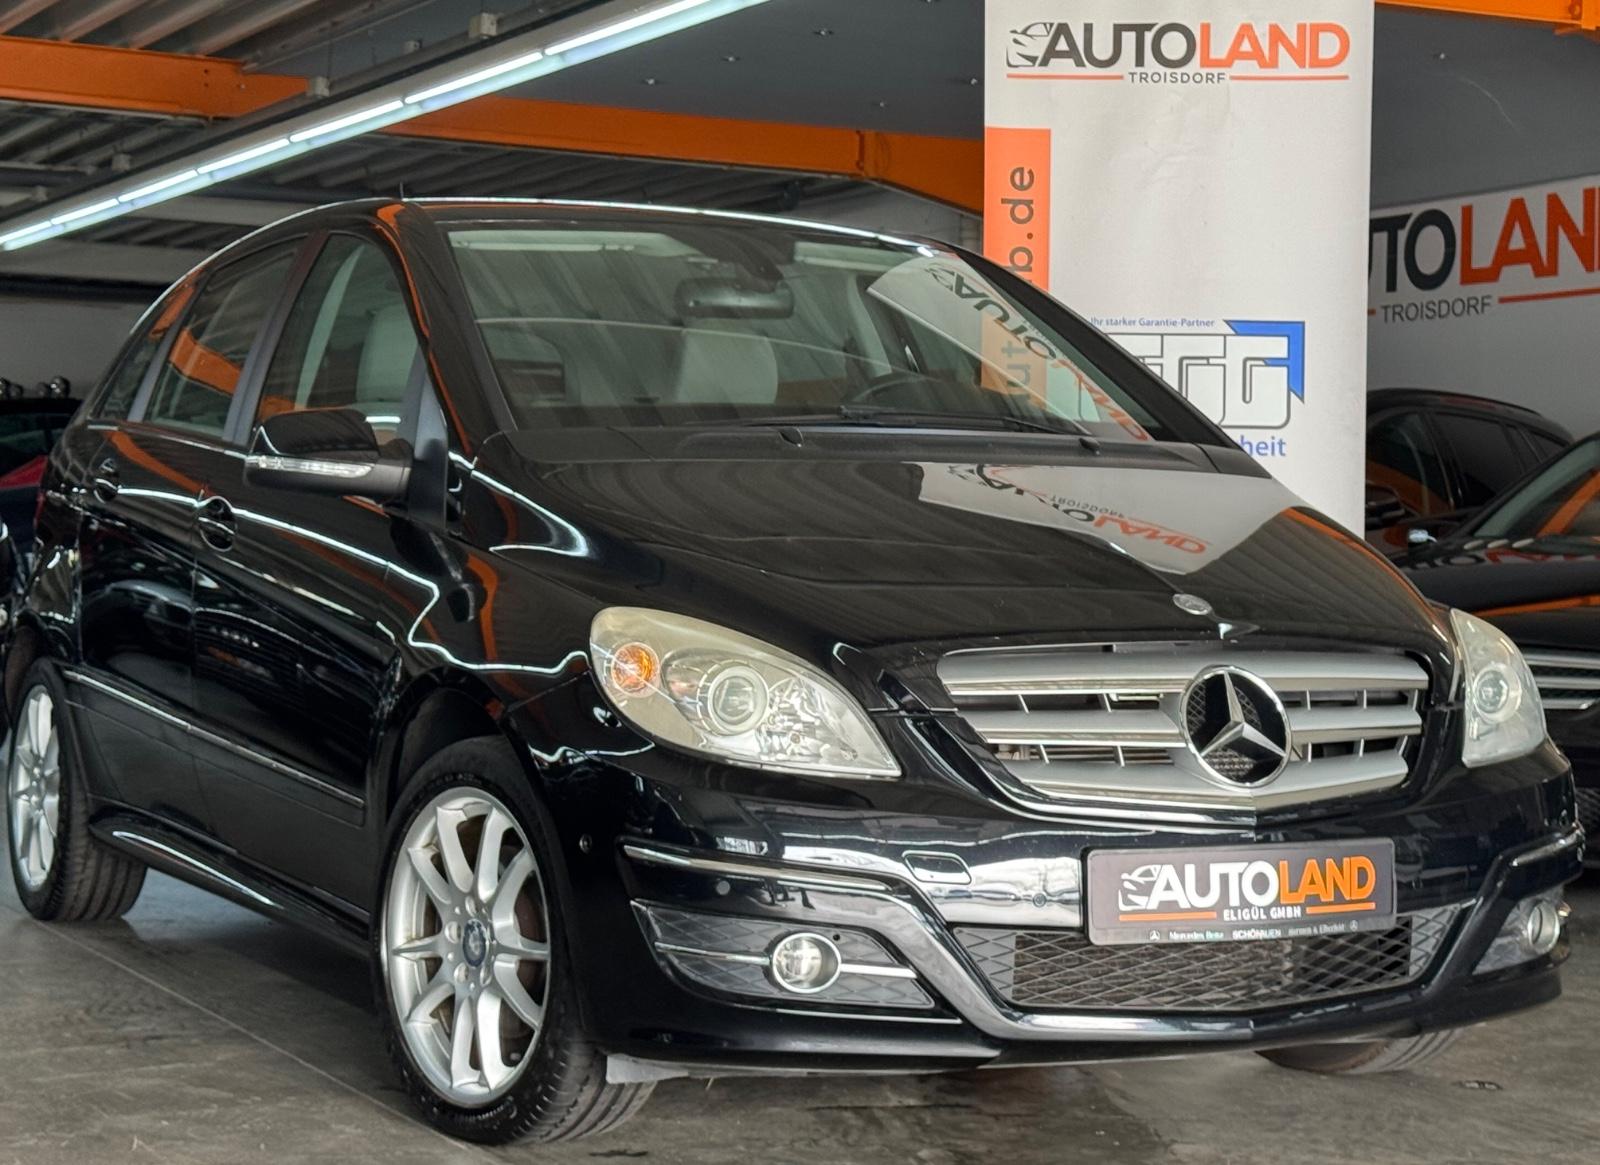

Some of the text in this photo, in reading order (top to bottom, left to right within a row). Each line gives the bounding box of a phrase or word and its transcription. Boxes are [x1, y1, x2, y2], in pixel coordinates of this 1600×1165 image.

[1039, 22, 1350, 69] AUTOLAND
[1128, 71, 1226, 84] TROISDORF
[1368, 186, 1600, 293] TOLAN
[1105, 317, 1136, 327] starker
[1139, 317, 1216, 328] Garantie-Partner
[1381, 295, 1492, 324] TROISDORF
[1147, 856, 1376, 910] AUTOLAND
[1224, 905, 1267, 922] ELIGÜL
